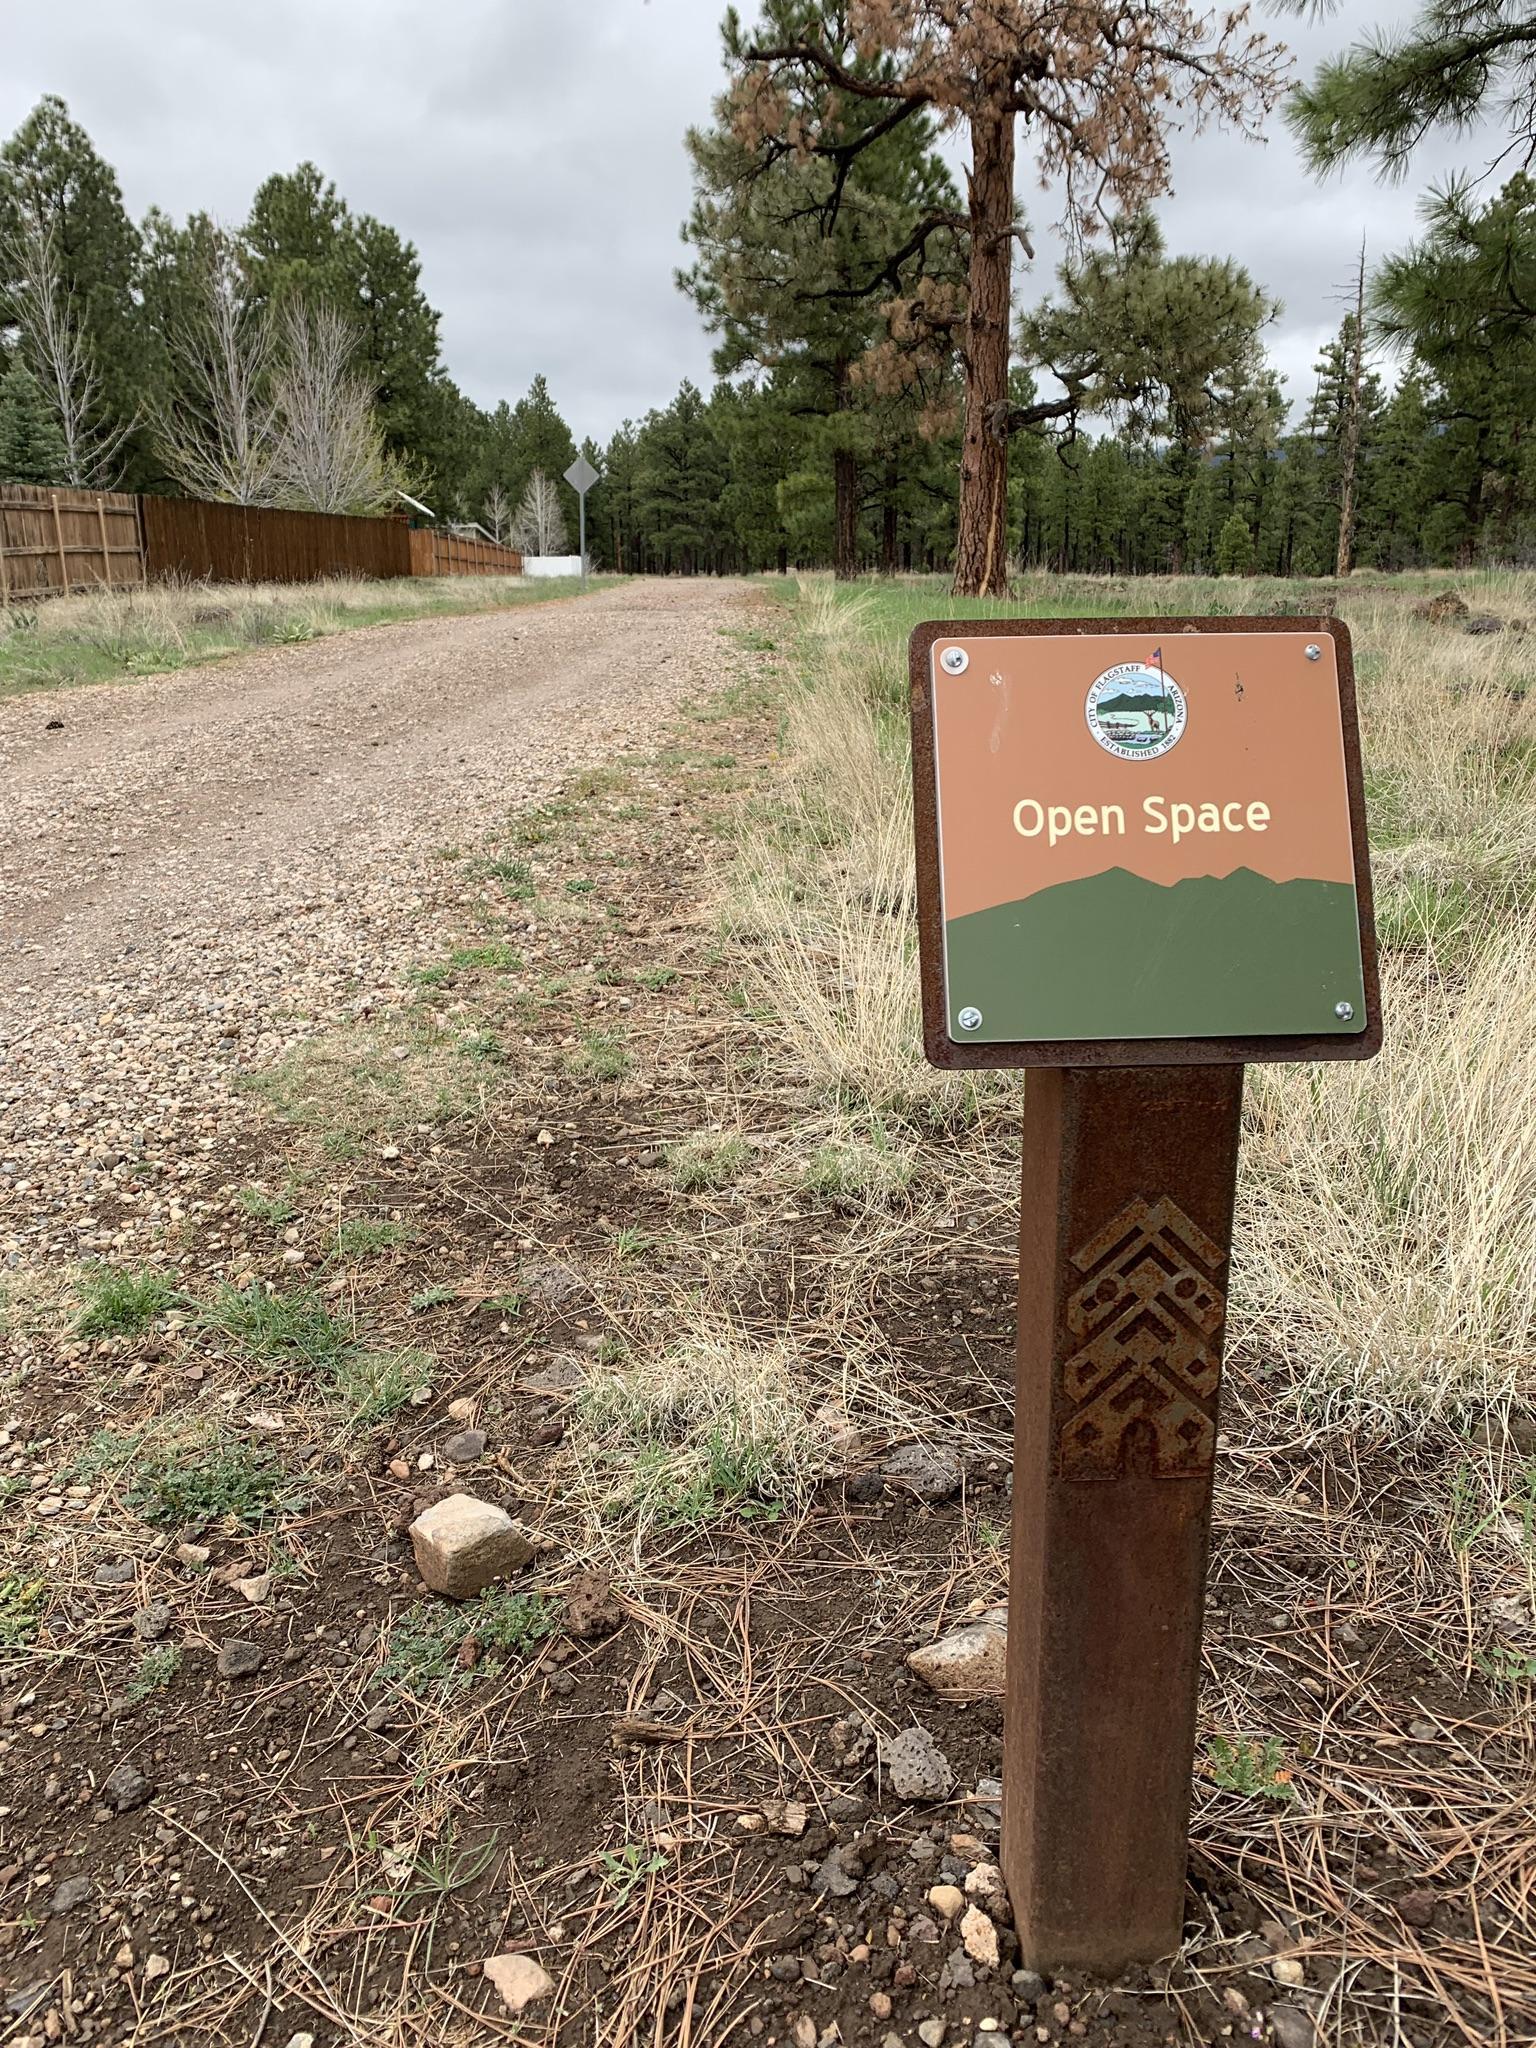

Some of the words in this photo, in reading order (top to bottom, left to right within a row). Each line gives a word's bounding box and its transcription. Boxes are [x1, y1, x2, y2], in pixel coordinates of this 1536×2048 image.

[1095, 665, 1140, 690] FLAGSTAFF
[1089, 693, 1098, 704] OF
[1168, 684, 1184, 724] ARIZONA
[1088, 707, 1098, 728] CITY
[1100, 736, 1159, 758] ESTABLISHED
[1162, 734, 1177, 749] 1882
[1013, 798, 1126, 848] Open
[1142, 795, 1271, 845] Space
